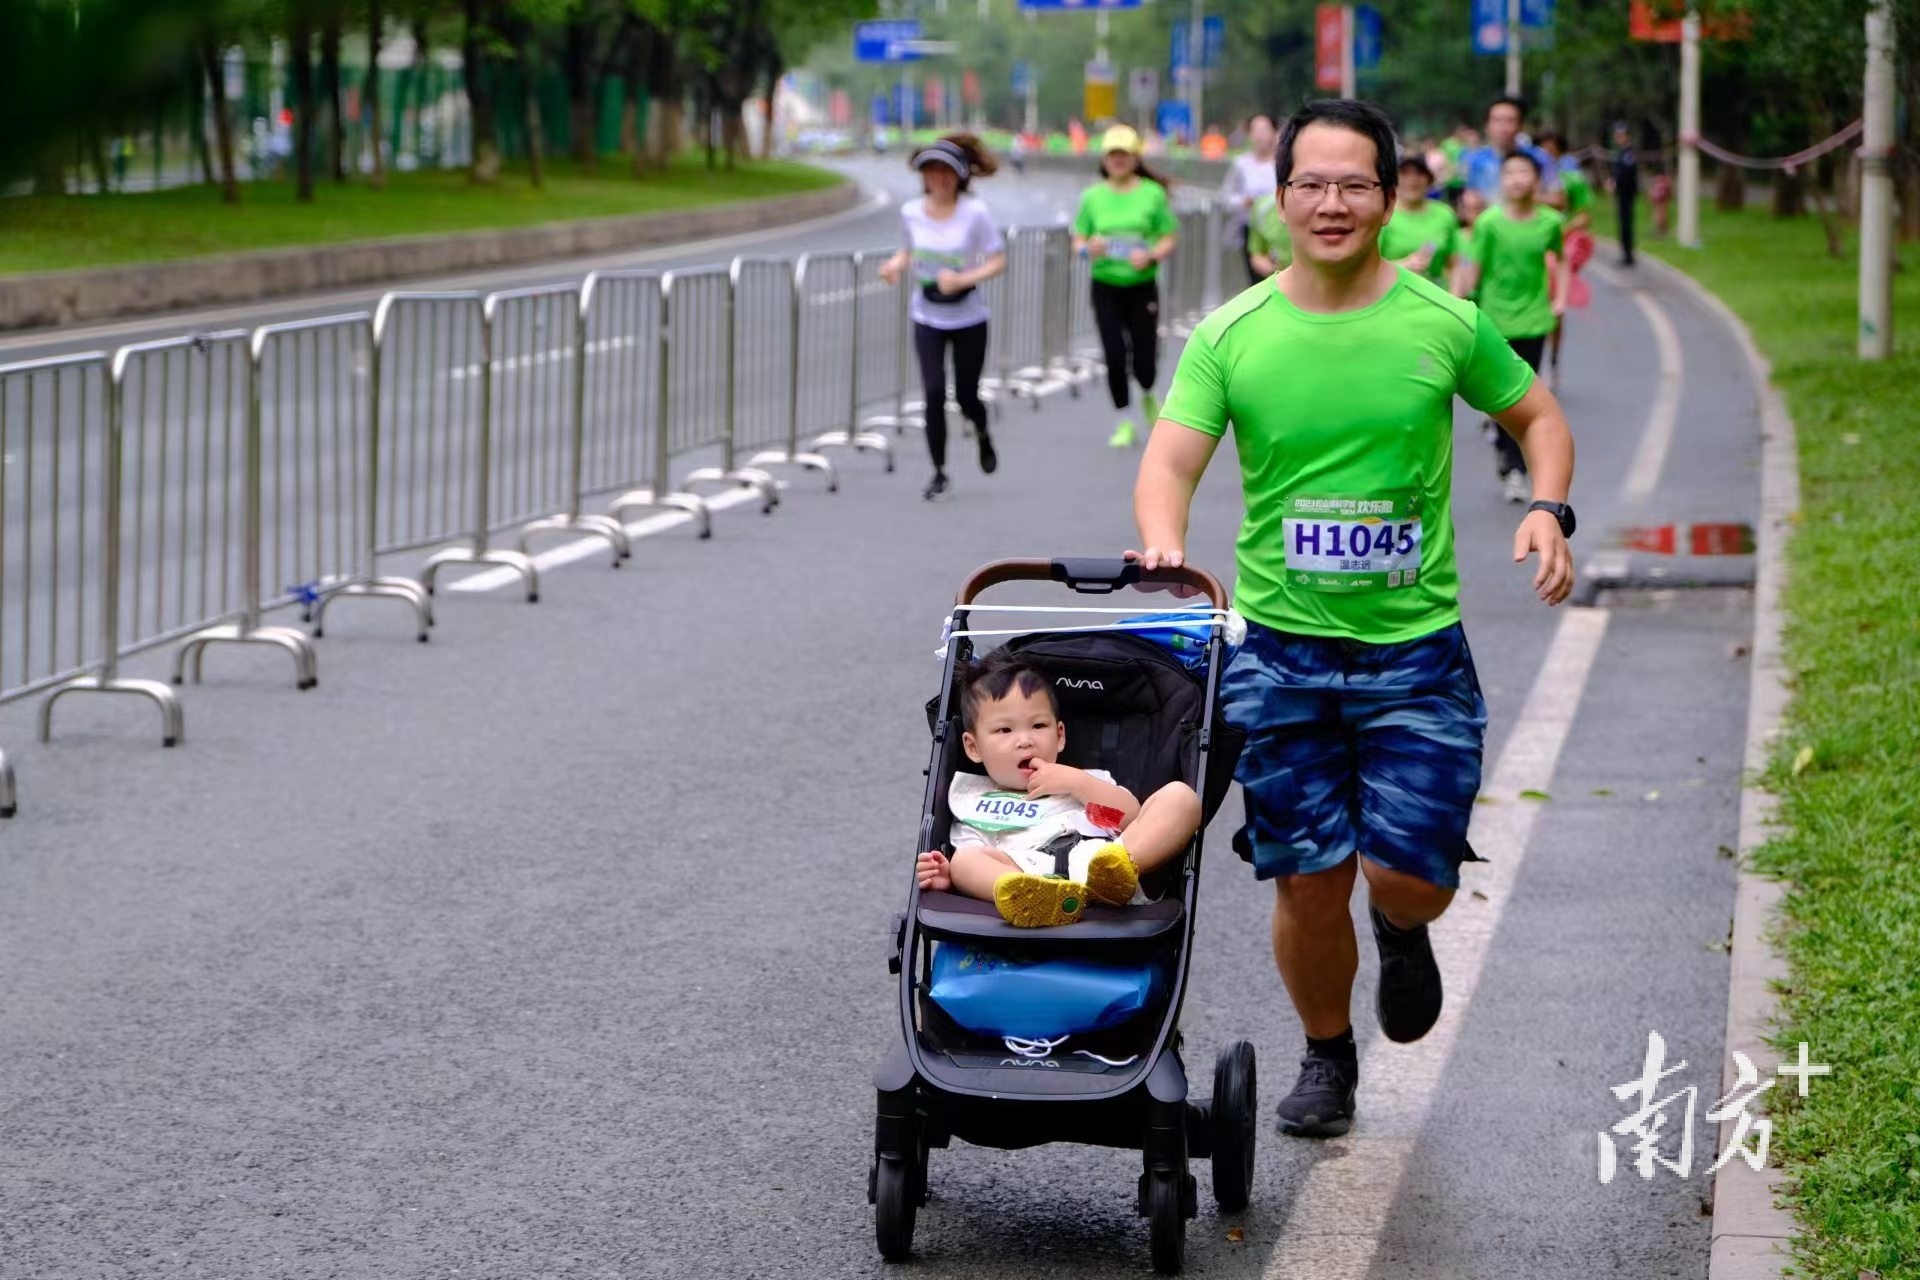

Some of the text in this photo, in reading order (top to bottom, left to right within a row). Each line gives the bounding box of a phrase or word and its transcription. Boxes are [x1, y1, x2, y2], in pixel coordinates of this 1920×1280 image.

[1295, 523, 1415, 557] H1045
[1055, 677, 1104, 690] nuna
[975, 800, 1039, 819] H1045
[1000, 1058, 1060, 1068] nuna
